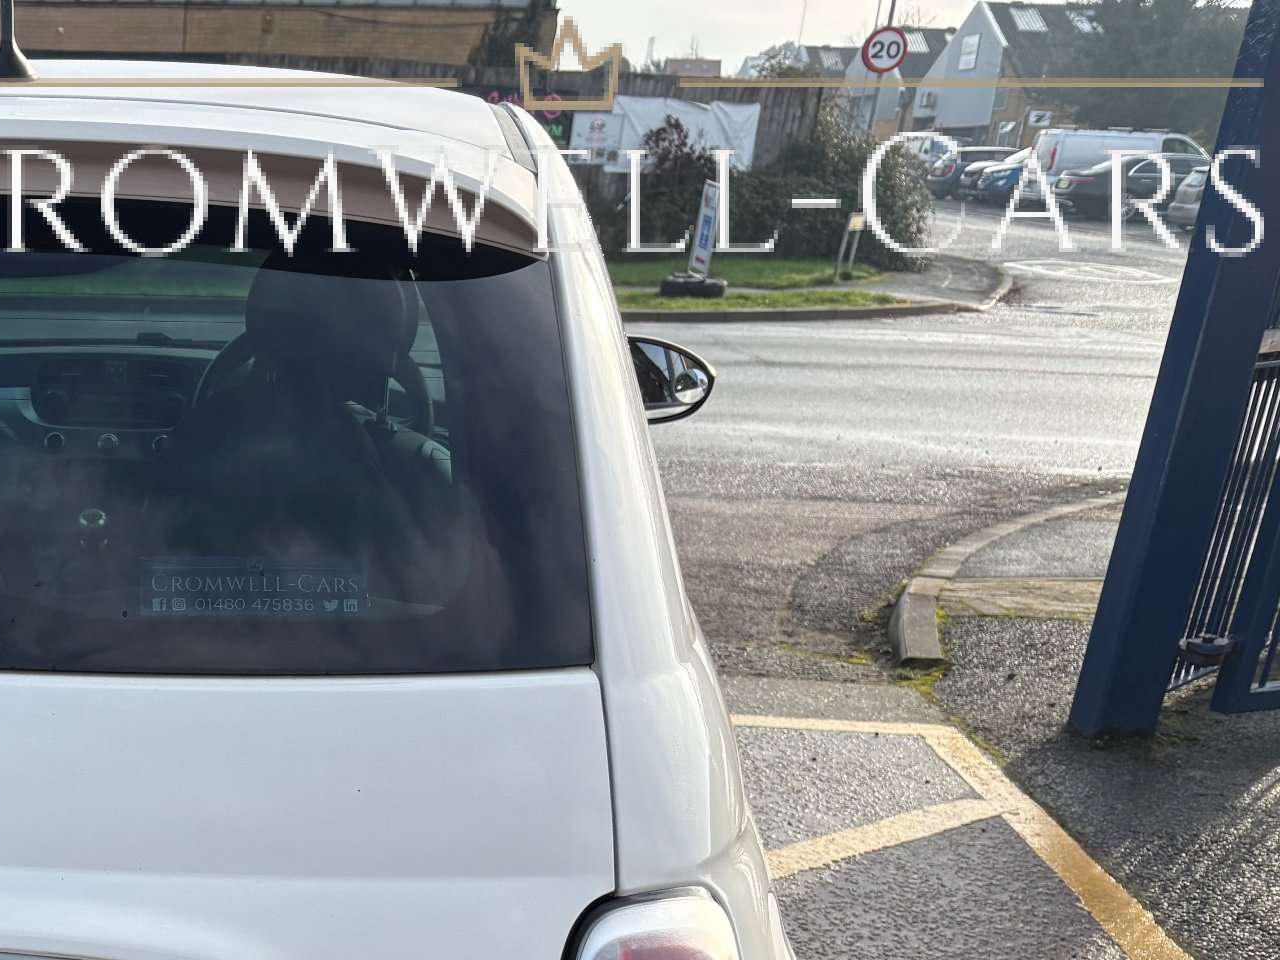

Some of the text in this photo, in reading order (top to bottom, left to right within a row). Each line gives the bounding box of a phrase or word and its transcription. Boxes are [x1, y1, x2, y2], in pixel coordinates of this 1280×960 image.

[870, 40, 901, 60] 20
[151, 575, 359, 593] CROMWELL-CARS
[195, 598, 315, 612] 01480 475836
